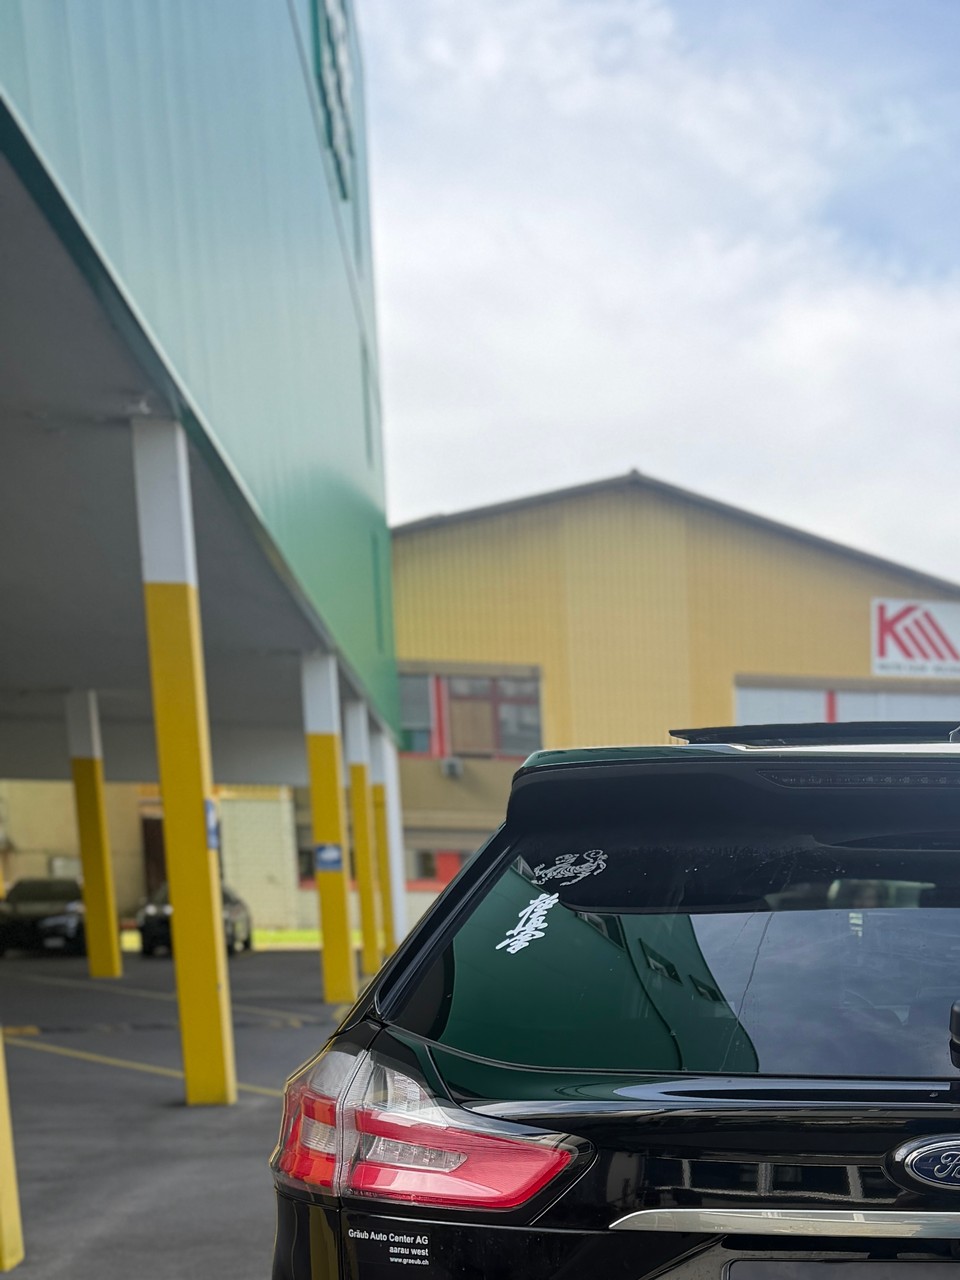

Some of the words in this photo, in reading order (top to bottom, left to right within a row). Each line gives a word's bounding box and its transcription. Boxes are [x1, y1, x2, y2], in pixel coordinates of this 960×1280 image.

[370, 1231, 388, 1242] Auto
[388, 1233, 414, 1244] Center
[415, 1235, 429, 1245] AG
[389, 1246, 410, 1255] aarau
[411, 1247, 429, 1256] west
